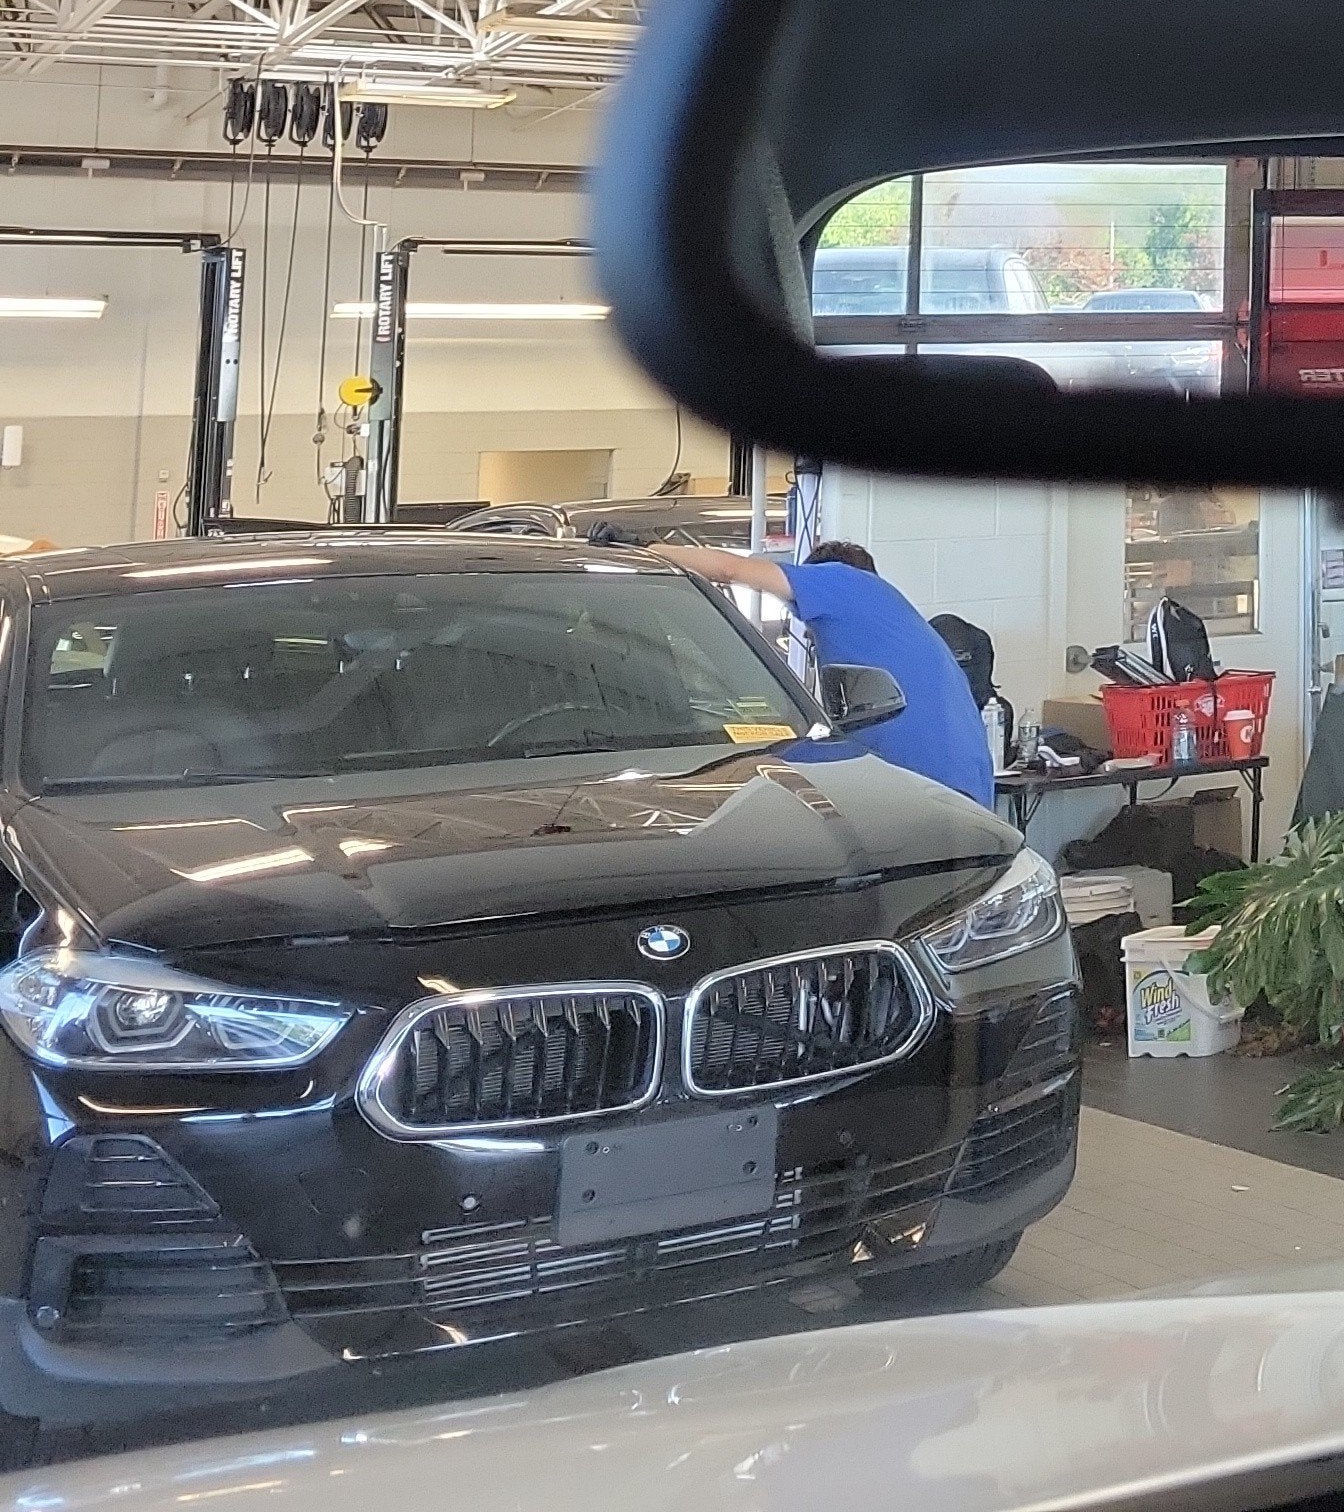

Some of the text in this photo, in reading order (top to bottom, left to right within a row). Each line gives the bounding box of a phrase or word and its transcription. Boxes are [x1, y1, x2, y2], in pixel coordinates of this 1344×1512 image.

[231, 249, 244, 278] LIFT
[377, 252, 395, 335] ROTARY LIFT
[1140, 976, 1174, 1010] Wind
[1143, 989, 1181, 1026] Fresh
